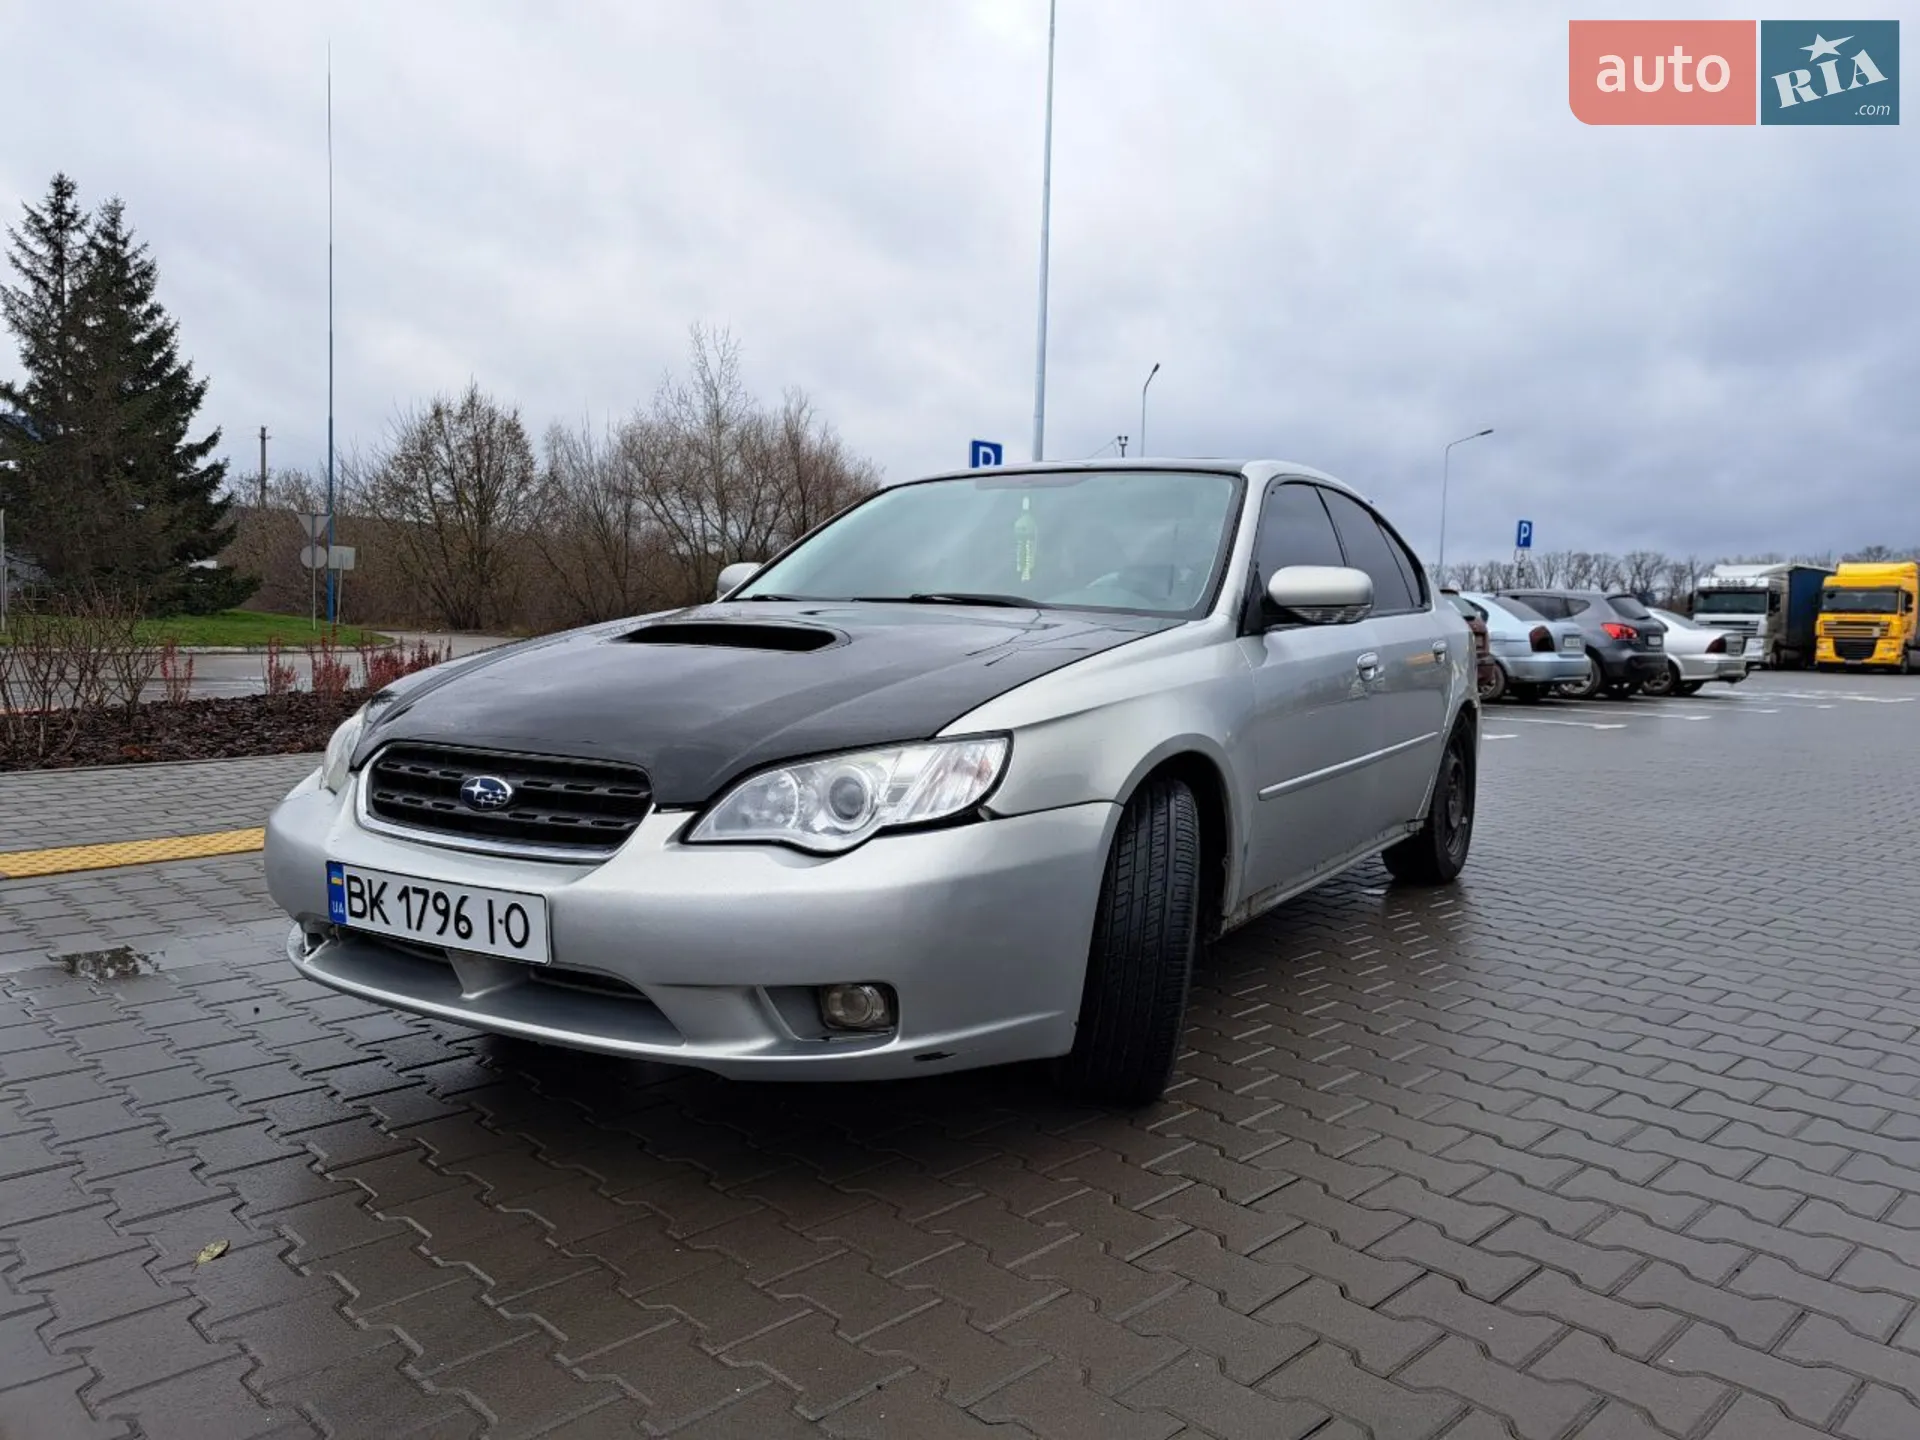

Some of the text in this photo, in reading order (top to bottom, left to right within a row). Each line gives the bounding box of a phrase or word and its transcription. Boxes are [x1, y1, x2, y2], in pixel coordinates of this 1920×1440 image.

[1520, 523, 1530, 545] P
[332, 901, 344, 914] UA
[346, 874, 391, 926] BK
[397, 885, 473, 940] 1796
